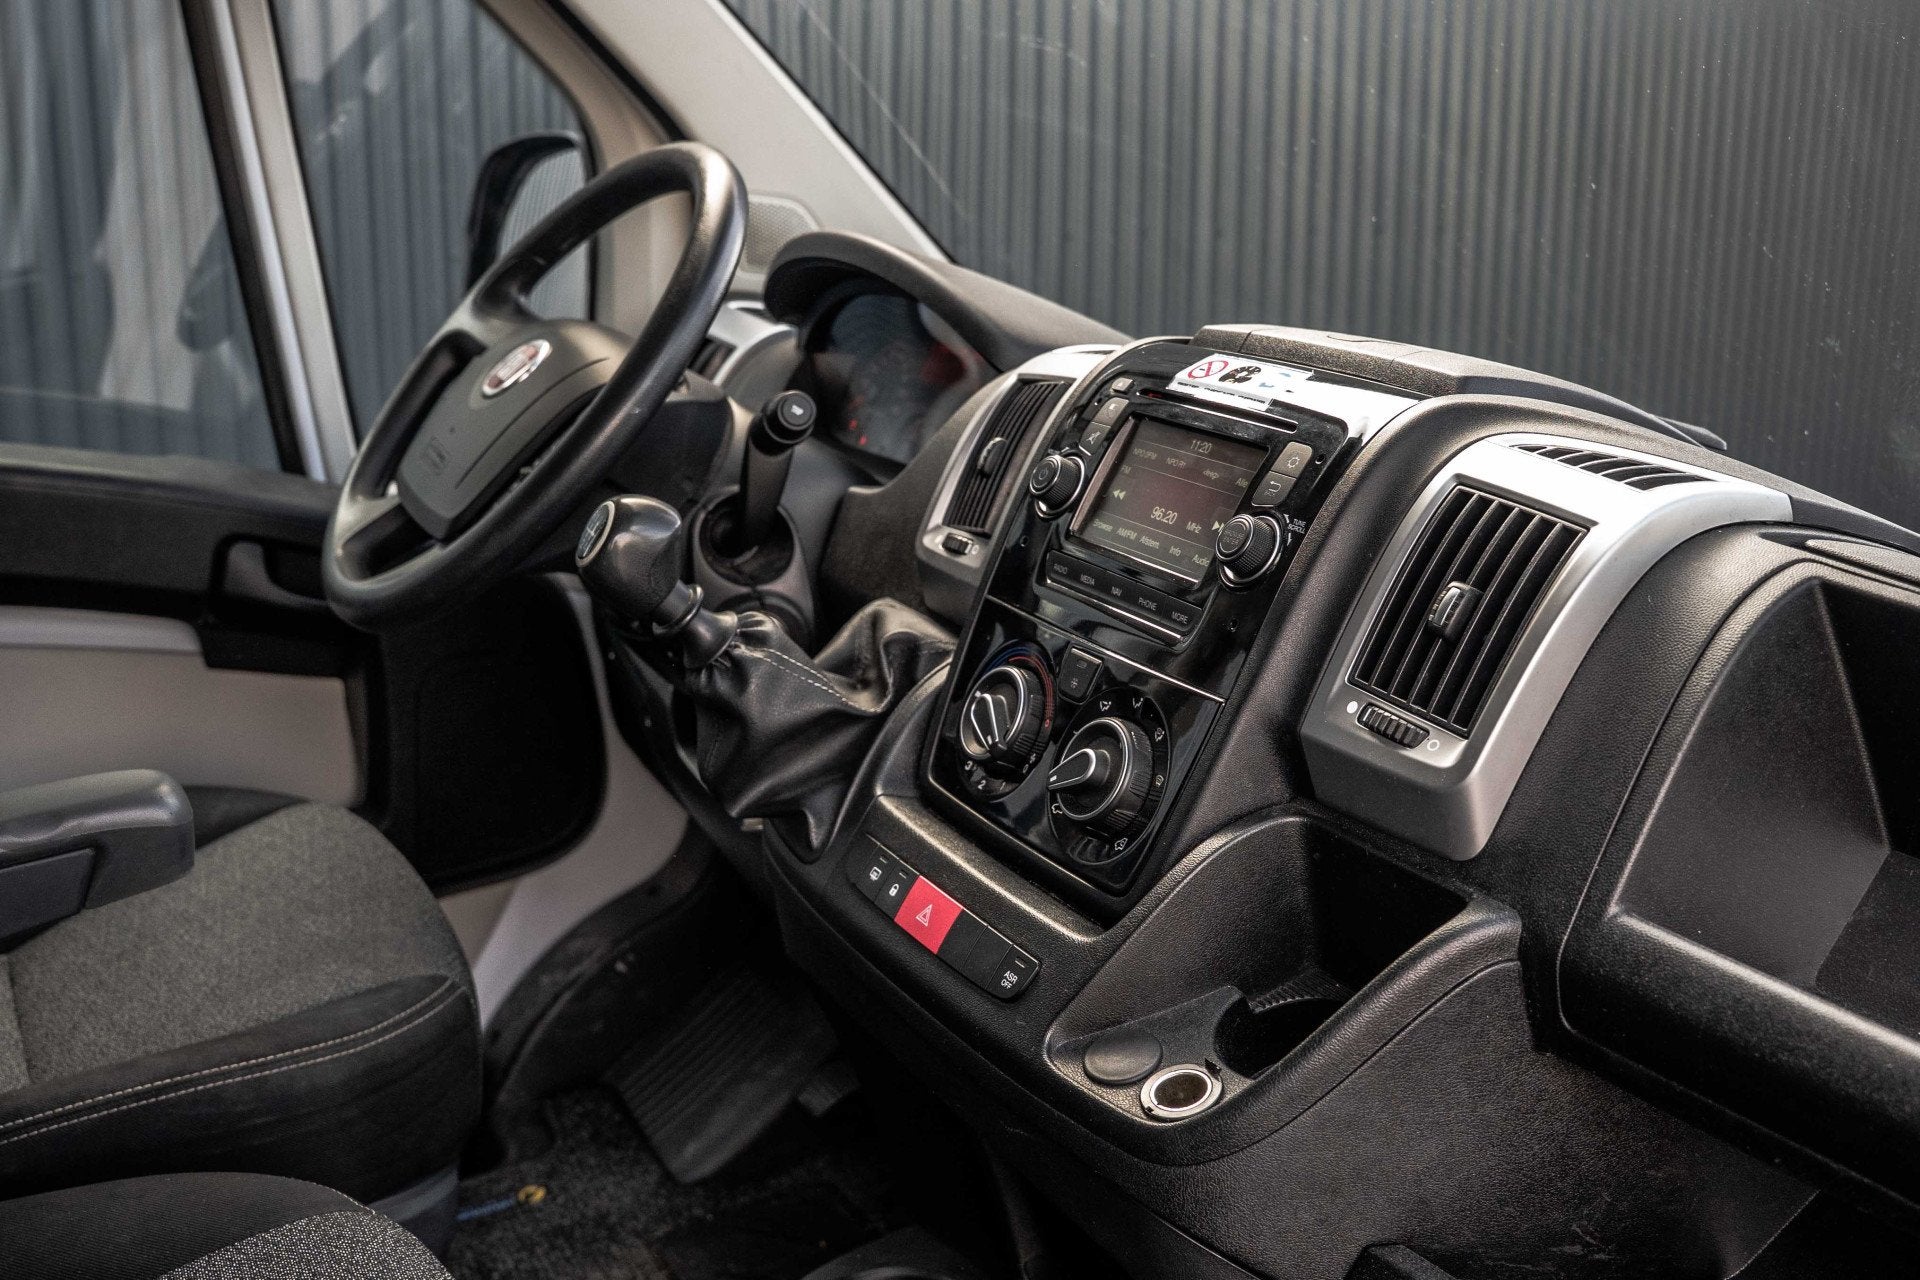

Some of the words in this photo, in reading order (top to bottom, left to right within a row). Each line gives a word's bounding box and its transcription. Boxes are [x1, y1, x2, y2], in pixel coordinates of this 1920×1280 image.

[1190, 439, 1213, 454] 11:20
[1121, 464, 1133, 475] FM
[1150, 506, 1178, 525] 96.20
[1186, 520, 1202, 534] MHz
[1287, 523, 1306, 534] SCROLL
[1293, 518, 1306, 528] TUNE
[1169, 545, 1182, 557] Info
[1192, 554, 1210, 567] Audio
[1053, 563, 1068, 575] RADIO
[1080, 573, 1095, 586] MEDIA
[1111, 586, 1122, 597] NAV
[1138, 597, 1158, 611] PHONE
[1171, 611, 1189, 625] MORE
[964, 760, 974, 771] 3
[977, 779, 987, 790] 2
[1003, 970, 1018, 985] ASR
[1000, 978, 1013, 990] OFF
